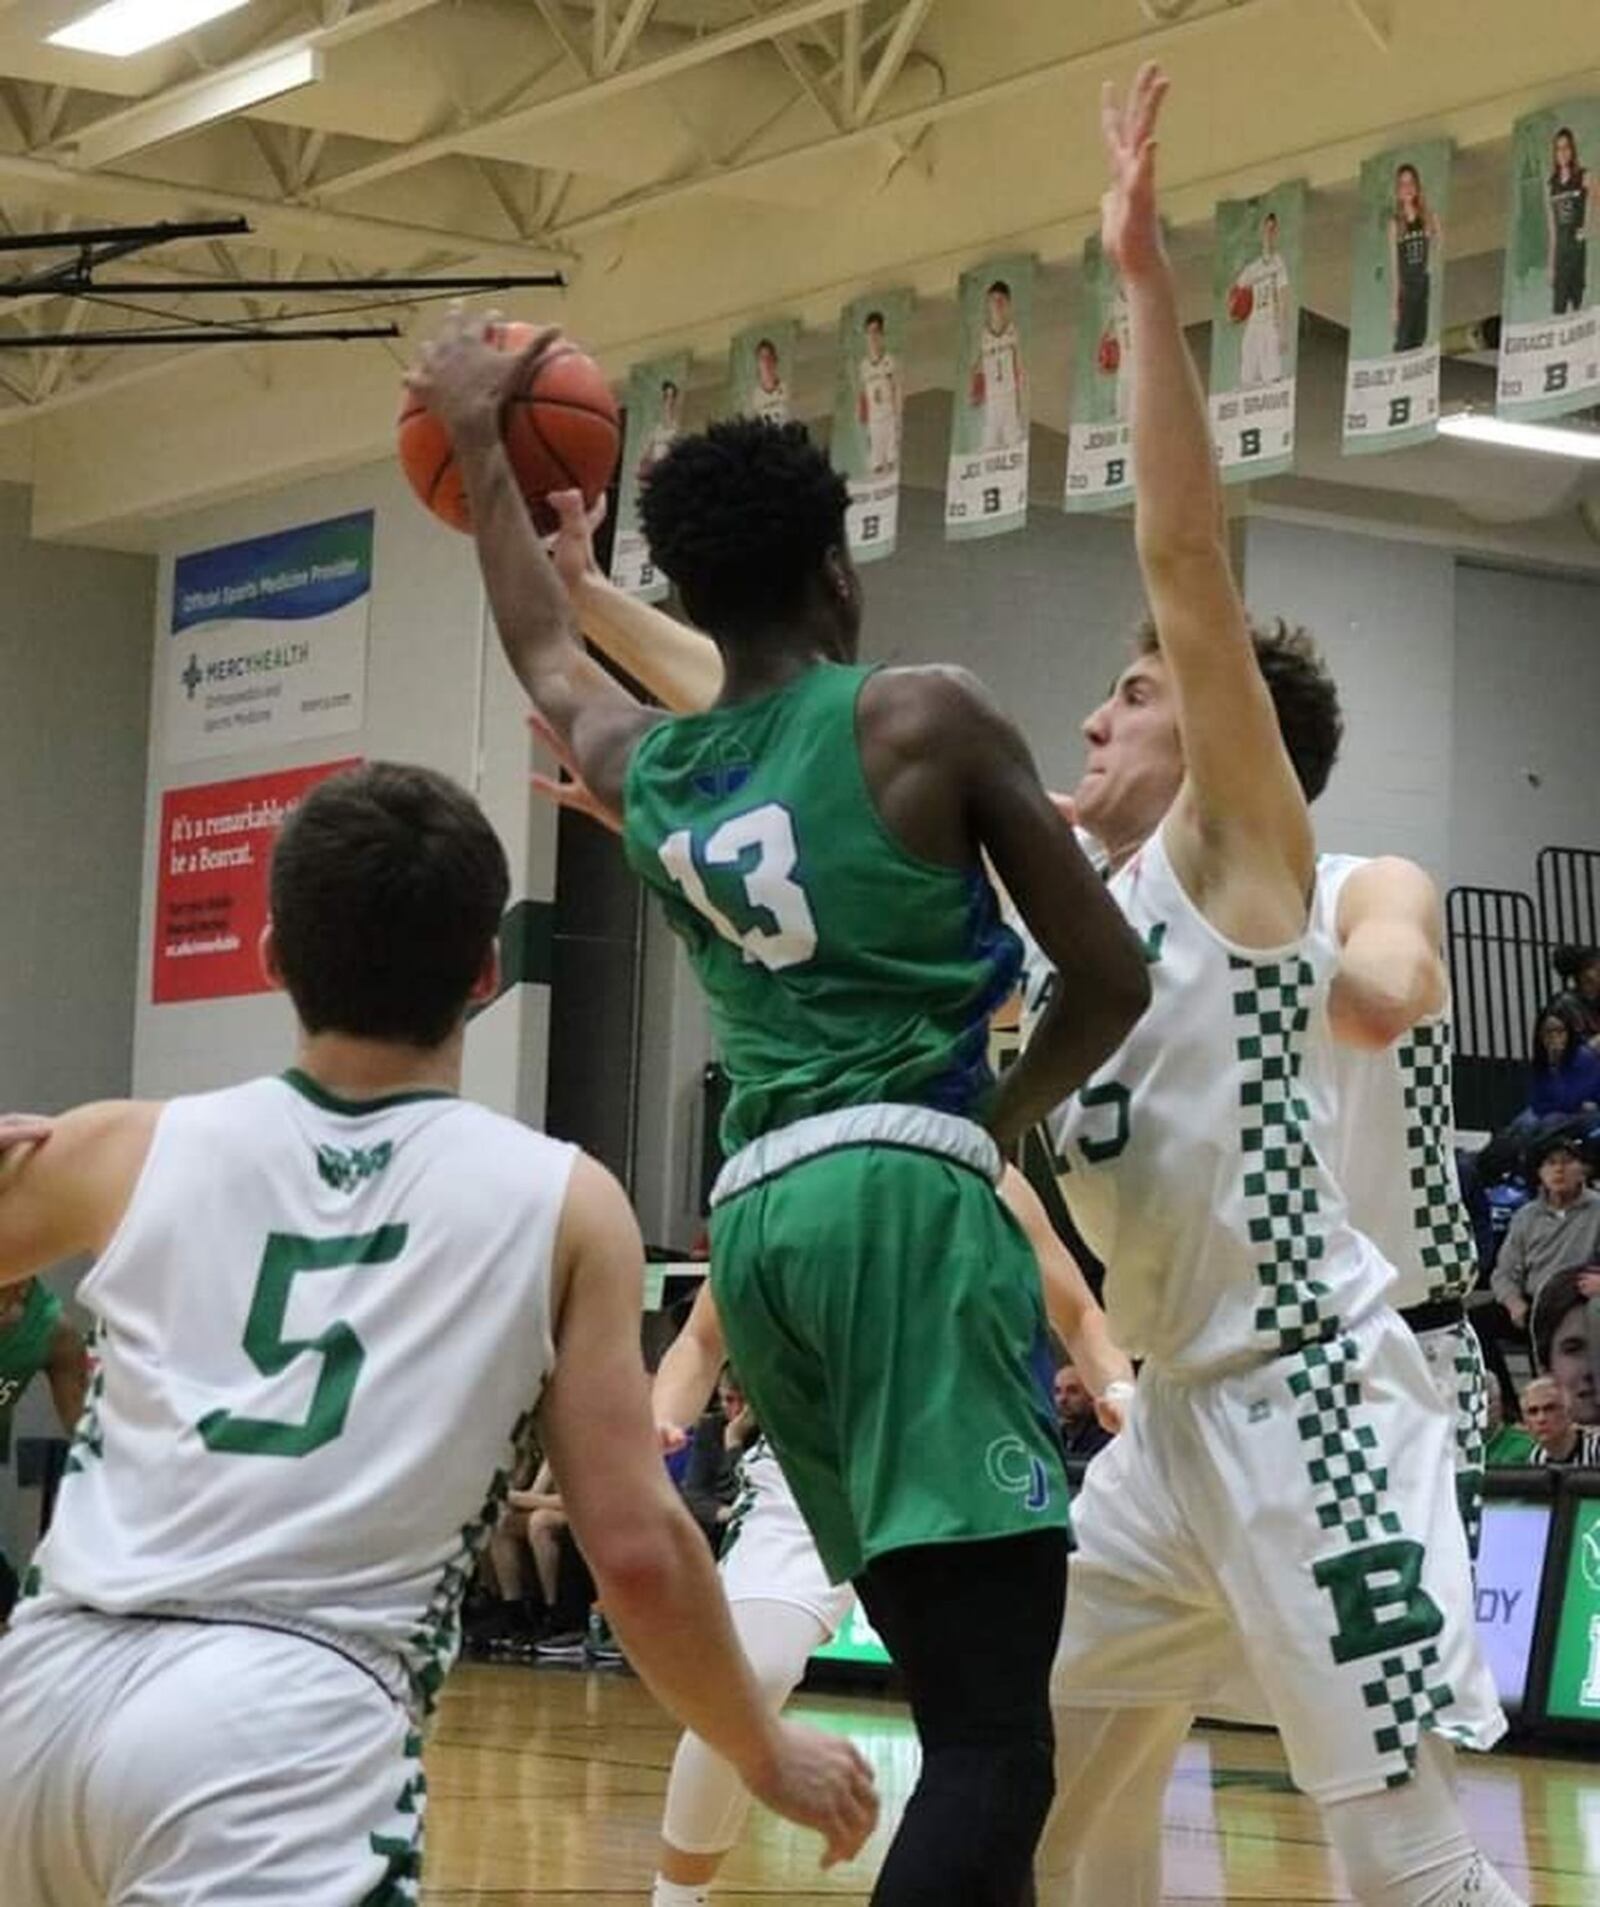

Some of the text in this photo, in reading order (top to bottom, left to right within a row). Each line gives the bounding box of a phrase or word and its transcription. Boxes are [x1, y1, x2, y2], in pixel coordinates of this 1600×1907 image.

[1543, 361, 1568, 392] B
[1388, 396, 1411, 427] B
[1240, 427, 1261, 457] B
[1105, 458, 1126, 487] B
[983, 487, 1001, 515] B
[861, 515, 880, 540] B
[640, 564, 655, 586] B
[206, 640, 309, 683] MERCYHEALTH
[657, 801, 819, 973] 13
[196, 1221, 409, 1459] 5
[1312, 1539, 1445, 1665] B
